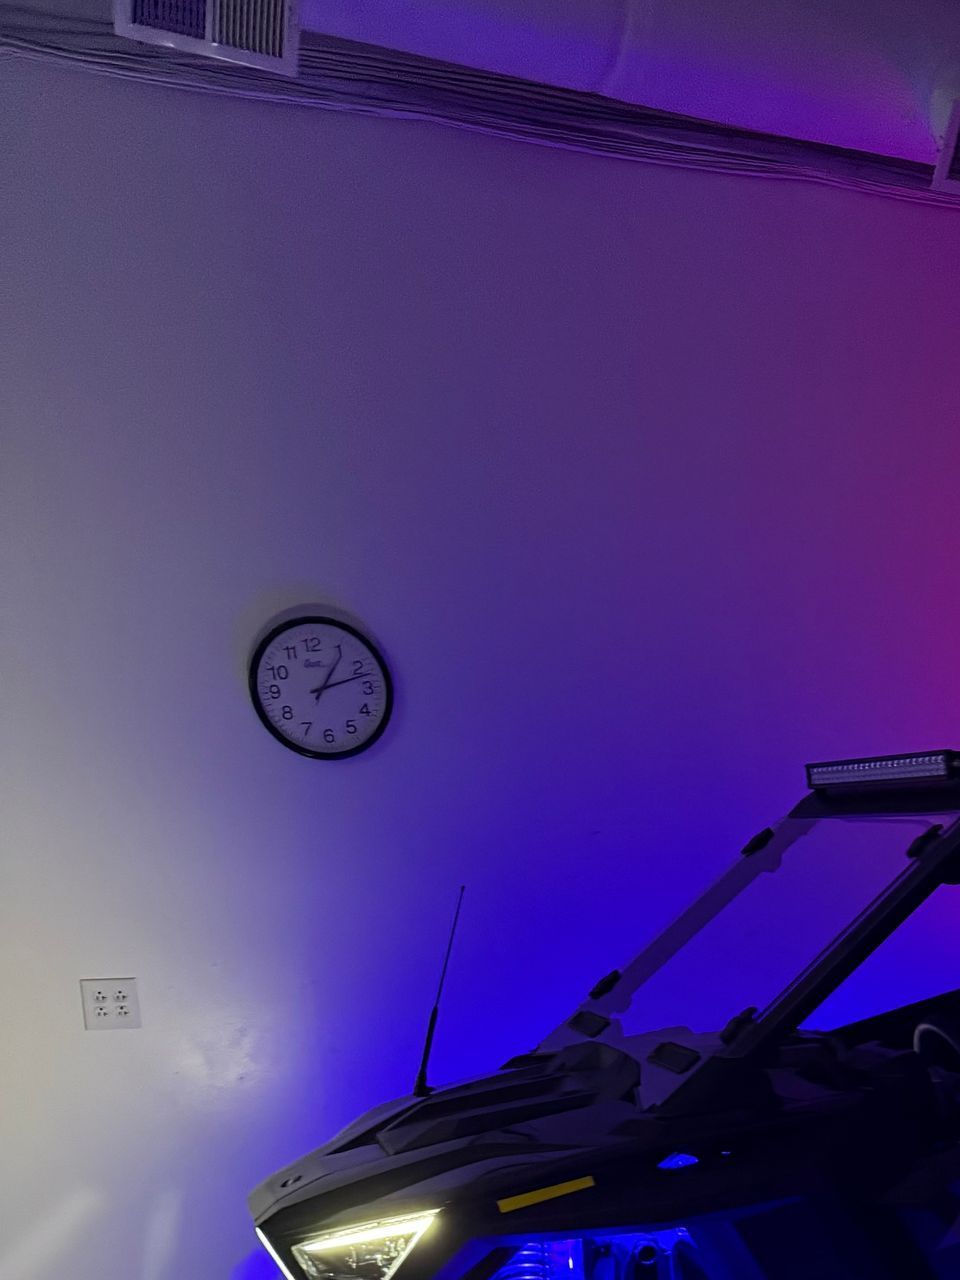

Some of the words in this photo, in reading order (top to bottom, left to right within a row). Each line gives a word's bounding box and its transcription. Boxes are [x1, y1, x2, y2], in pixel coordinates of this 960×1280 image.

[302, 637, 321, 652] 12
[335, 644, 342, 658] 1
[283, 646, 297, 660] 11
[267, 665, 288, 680] 10
[352, 660, 363, 675] 2
[269, 685, 280, 699] 9
[363, 681, 374, 695] 3
[282, 705, 293, 720] 8
[360, 704, 371, 716] 4
[301, 722, 312, 736] 7
[346, 720, 357, 734] 5
[323, 728, 335, 743] 6
